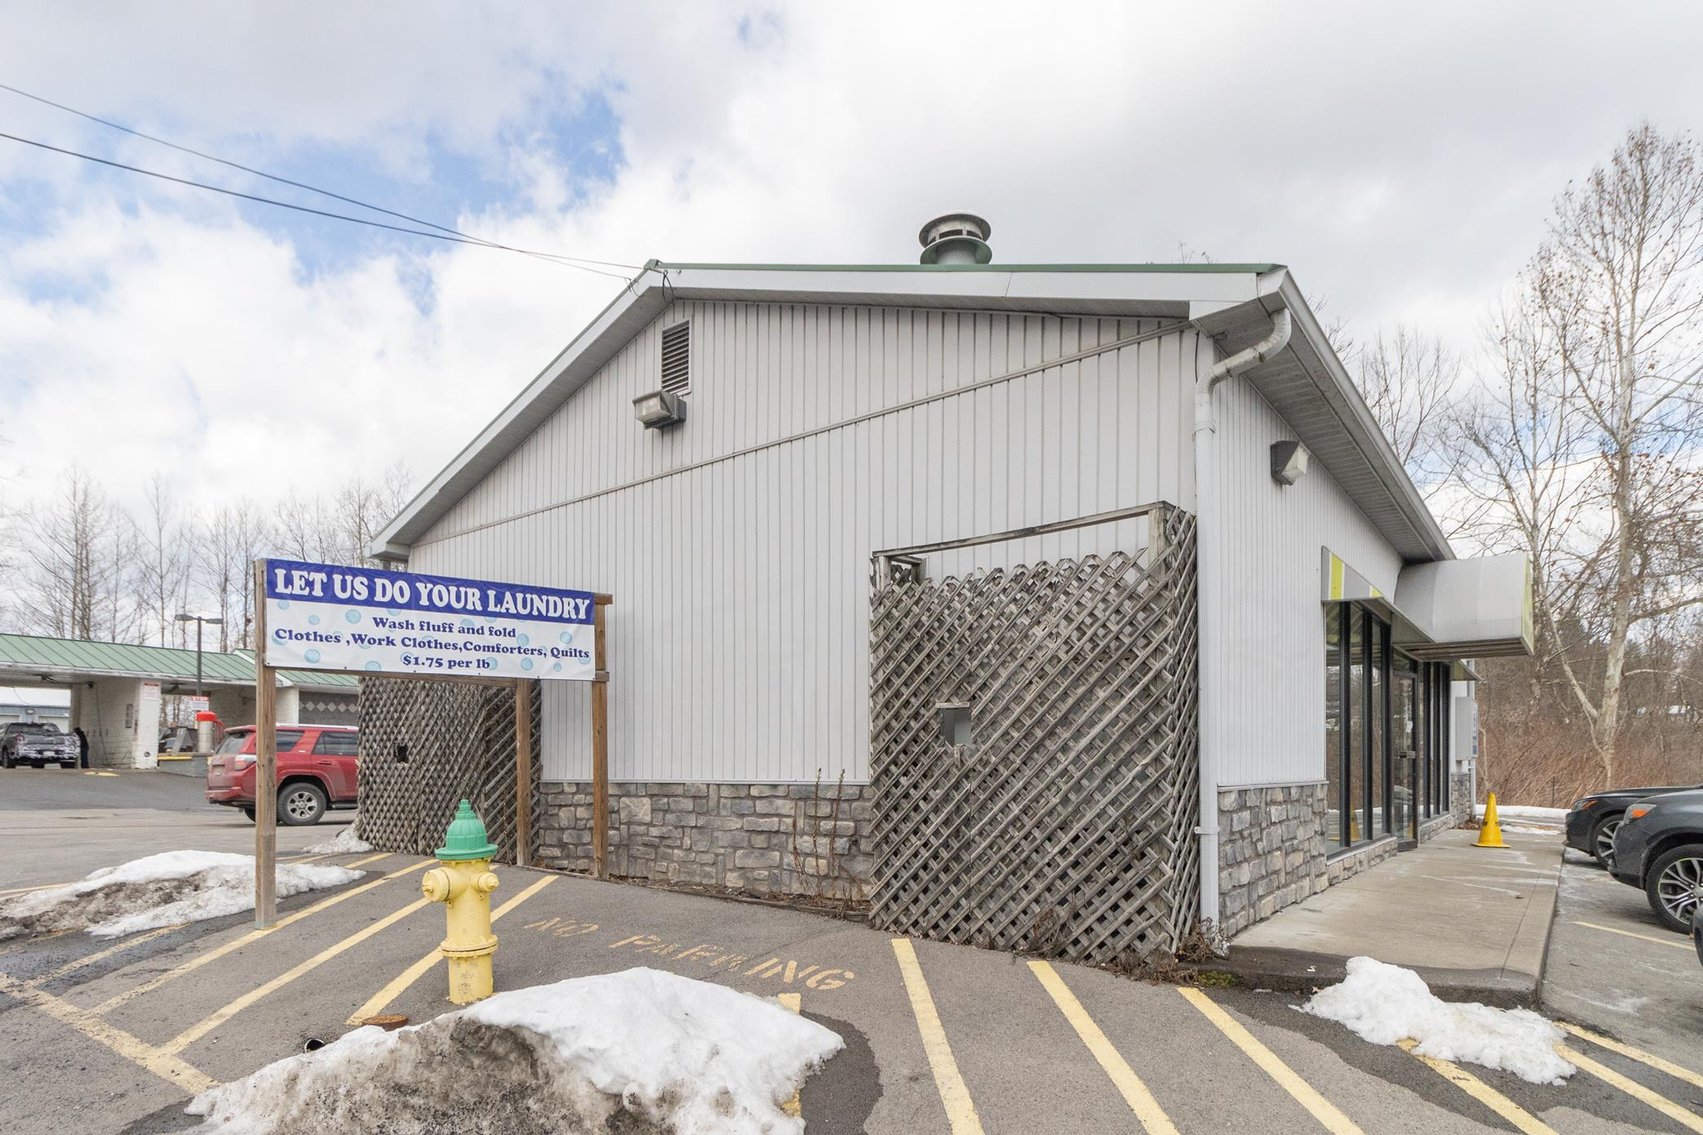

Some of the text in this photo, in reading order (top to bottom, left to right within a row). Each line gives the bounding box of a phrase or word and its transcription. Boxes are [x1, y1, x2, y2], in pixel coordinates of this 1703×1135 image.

[275, 568, 590, 620] LET US DO YOUR LAUNDRY
[372, 617, 516, 638] Wash fluff and fold
[275, 628, 341, 644] Clothes
[550, 647, 590, 659] Quilts
[403, 655, 490, 669] $1.75 per lb
